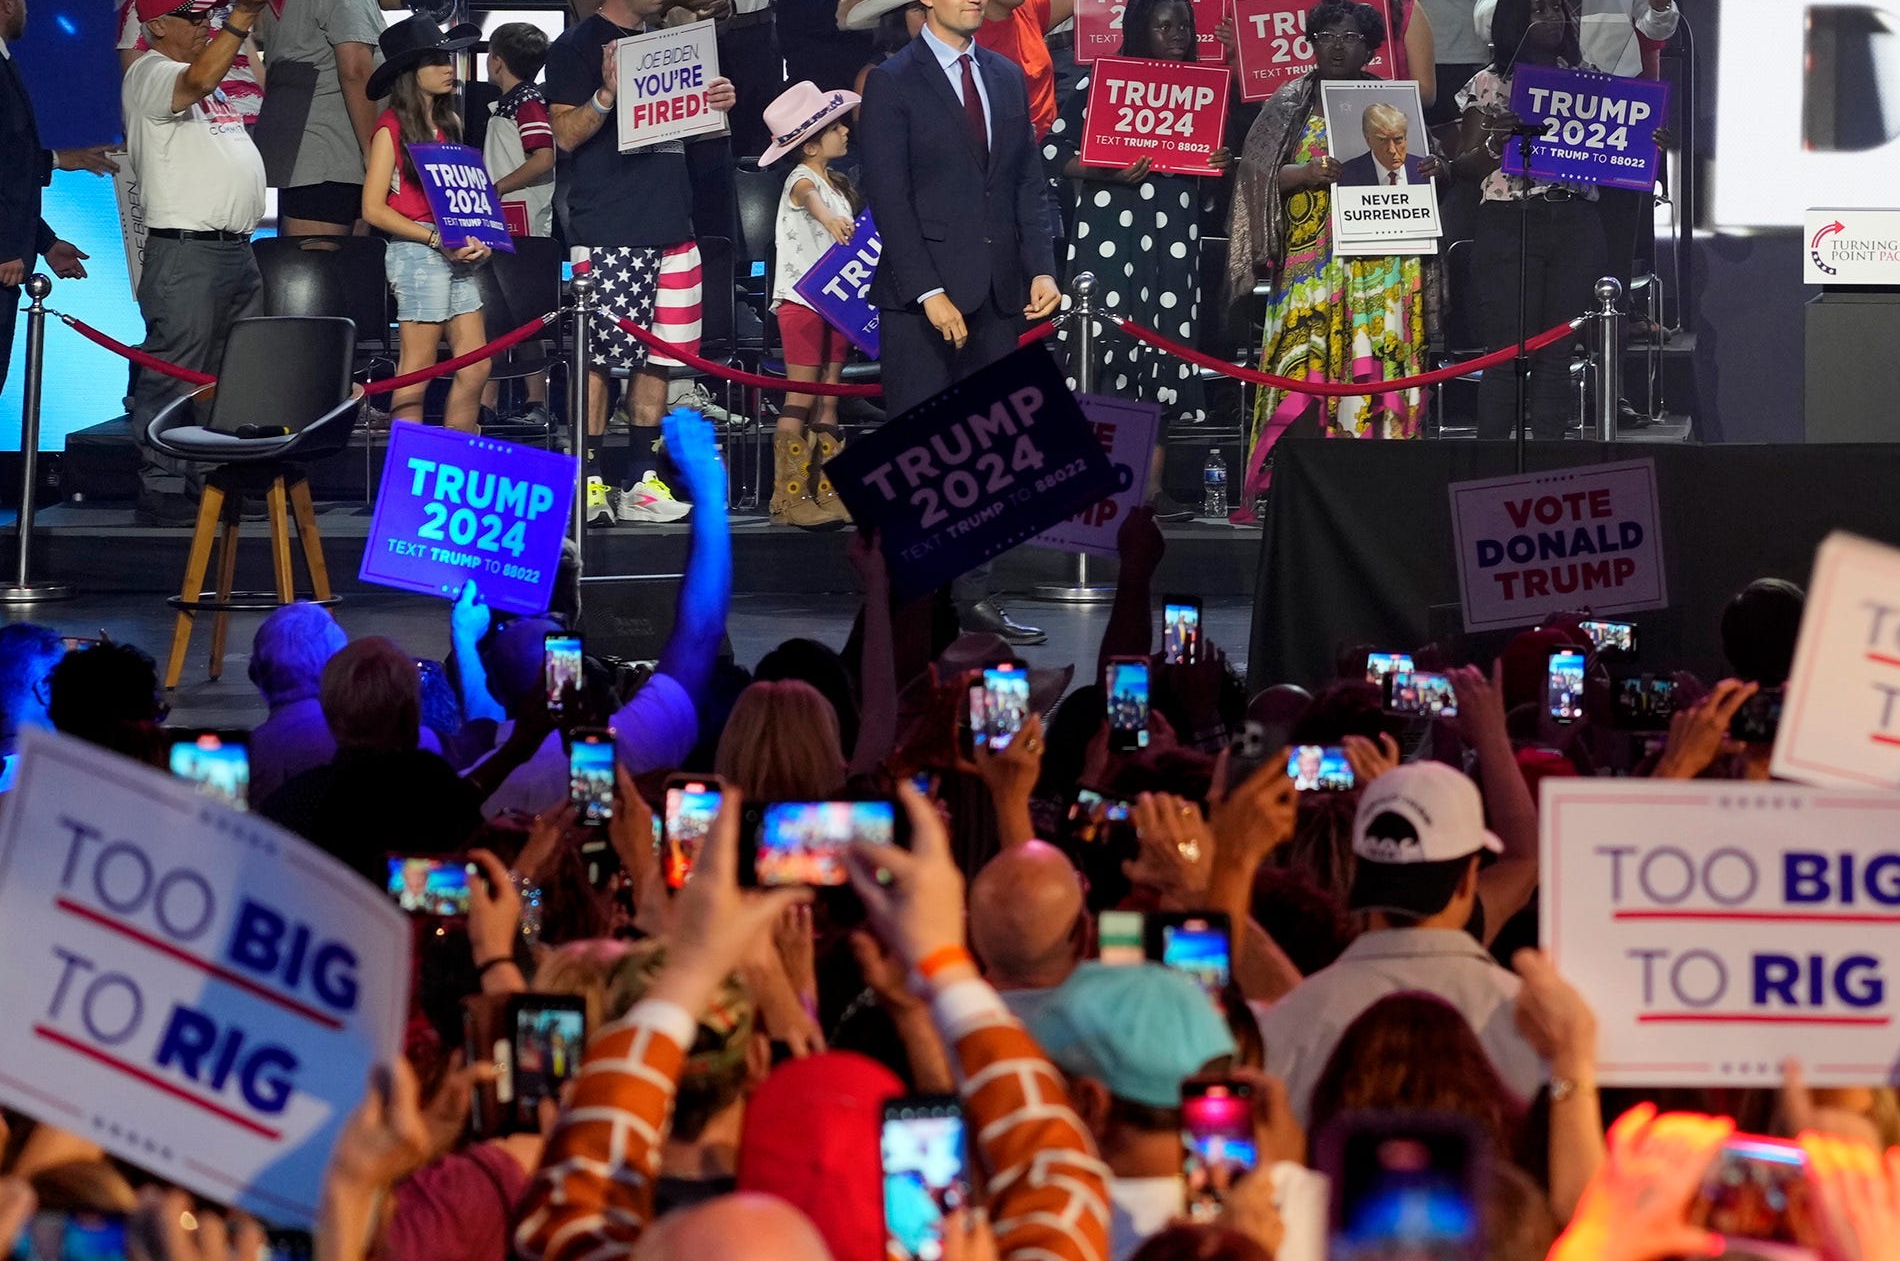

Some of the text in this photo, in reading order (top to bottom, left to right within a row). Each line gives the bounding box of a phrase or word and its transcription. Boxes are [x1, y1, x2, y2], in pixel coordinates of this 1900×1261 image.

[1089, 34, 1117, 43] TEXT
[1270, 39, 1315, 63] 20
[636, 51, 662, 71] JOE
[1253, 64, 1319, 79] TEXT TRUM
[633, 64, 703, 98] YOU'RE
[1106, 79, 1214, 111] TRUMP
[633, 91, 709, 129] FIRED!
[1115, 107, 1194, 137] 2024
[1528, 87, 1651, 126] TRUMP
[1095, 135, 1210, 153] TEXT TRUMP TO 88022
[1539, 117, 1628, 151] 2024
[1550, 148, 1589, 160] TRUMP
[1592, 153, 1608, 164] TO
[1610, 155, 1645, 168] 88022
[424, 163, 488, 191] TRUMP
[445, 189, 492, 215] 2024
[1344, 208, 1430, 221] SURRENDER
[1361, 194, 1409, 206] NEVER
[443, 217, 458, 226] TEXT
[458, 218, 482, 228] TRUMP
[1830, 240, 1898, 251] TURNING
[1831, 251, 1876, 262] POINT
[822, 232, 883, 301] TRU
[862, 384, 1046, 502] TRUMP
[407, 457, 554, 521] TRUMP
[909, 434, 1045, 530] 2024
[900, 457, 1089, 563] TEXT TRUMP TO 88022
[1503, 489, 1613, 529] VOTE
[417, 503, 526, 558] 2024
[1476, 521, 1644, 569] DONALD
[387, 539, 541, 584] TEXT TRUMP TO 88022
[1494, 557, 1637, 602] TRUMP
[1595, 845, 1758, 907] TOO
[57, 815, 360, 1012] TOO BIG
[1627, 947, 1887, 1010] TO RIG
[48, 946, 299, 1116] TO RIG
